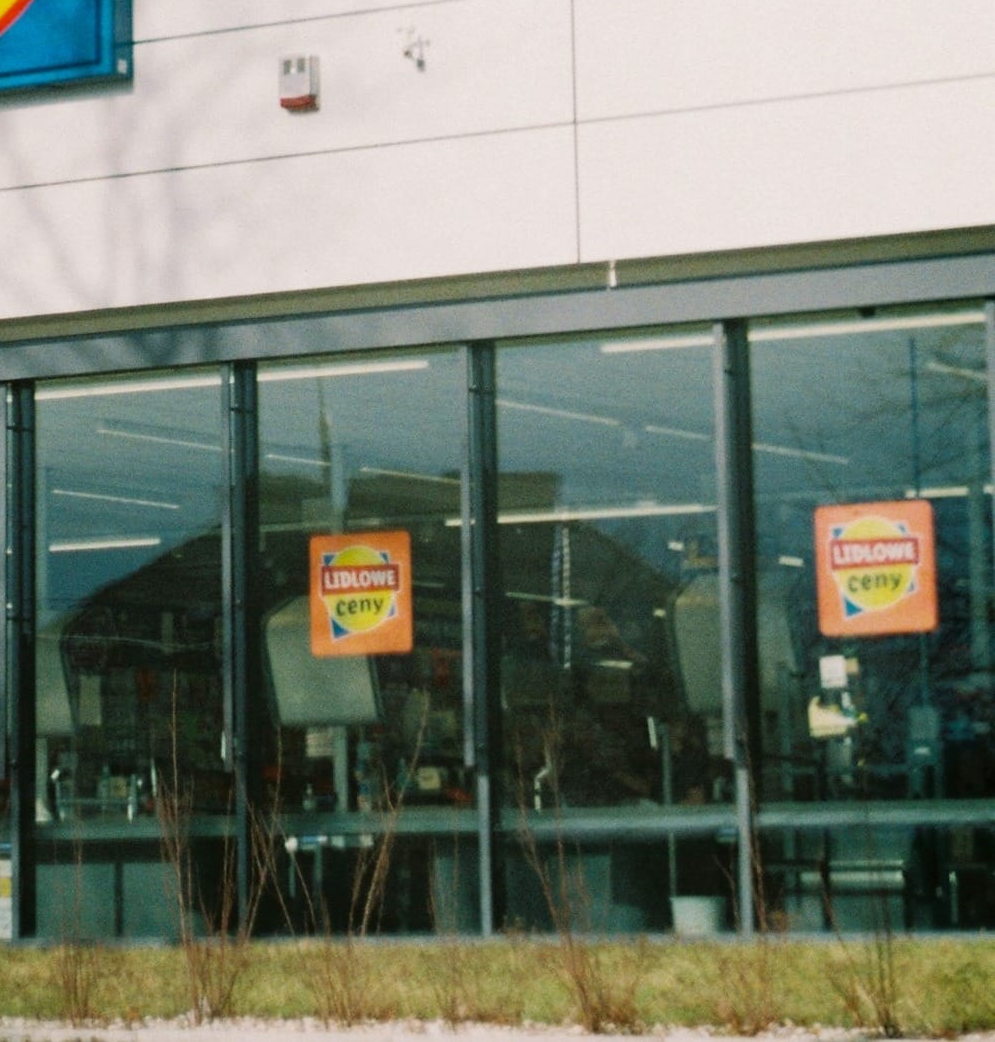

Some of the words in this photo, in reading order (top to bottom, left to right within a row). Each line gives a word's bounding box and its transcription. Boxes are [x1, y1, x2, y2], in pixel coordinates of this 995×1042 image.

[833, 541, 914, 564] LIDLOWE
[325, 569, 395, 589] LIDLOWE
[848, 574, 902, 593] ceny
[336, 598, 384, 616] ceny
